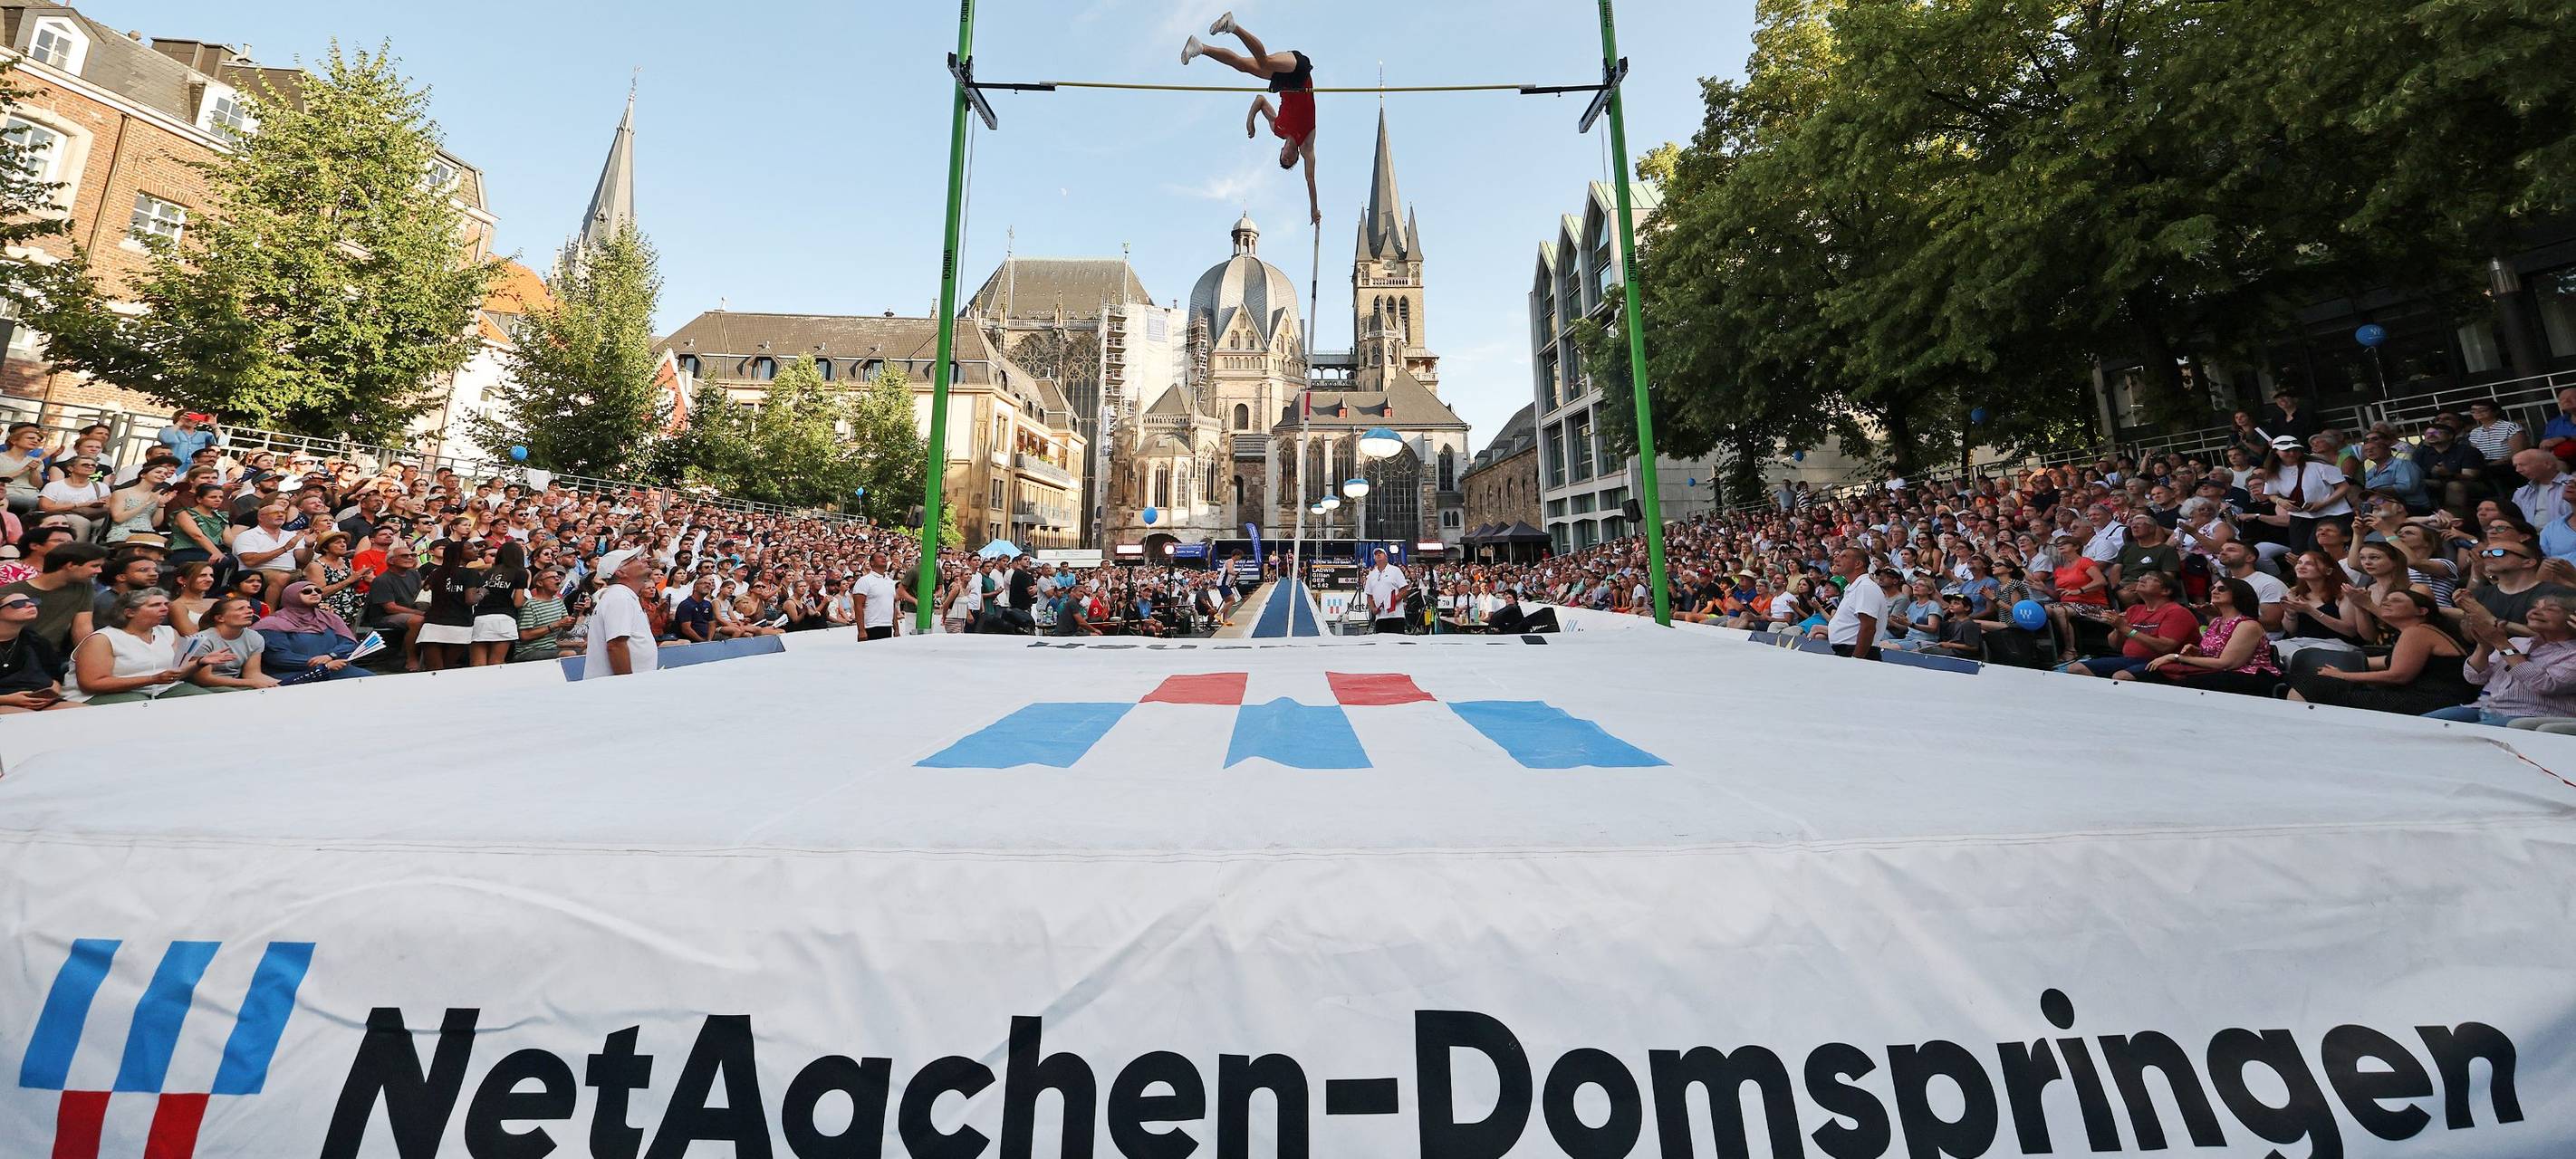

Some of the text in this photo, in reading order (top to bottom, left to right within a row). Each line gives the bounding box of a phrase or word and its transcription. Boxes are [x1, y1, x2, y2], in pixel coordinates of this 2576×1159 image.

[960, 0, 970, 23] INDICO
[942, 249, 953, 280] VINDICO
[1626, 253, 1638, 282] VINDICO
[482, 580, 512, 589] ACHEN
